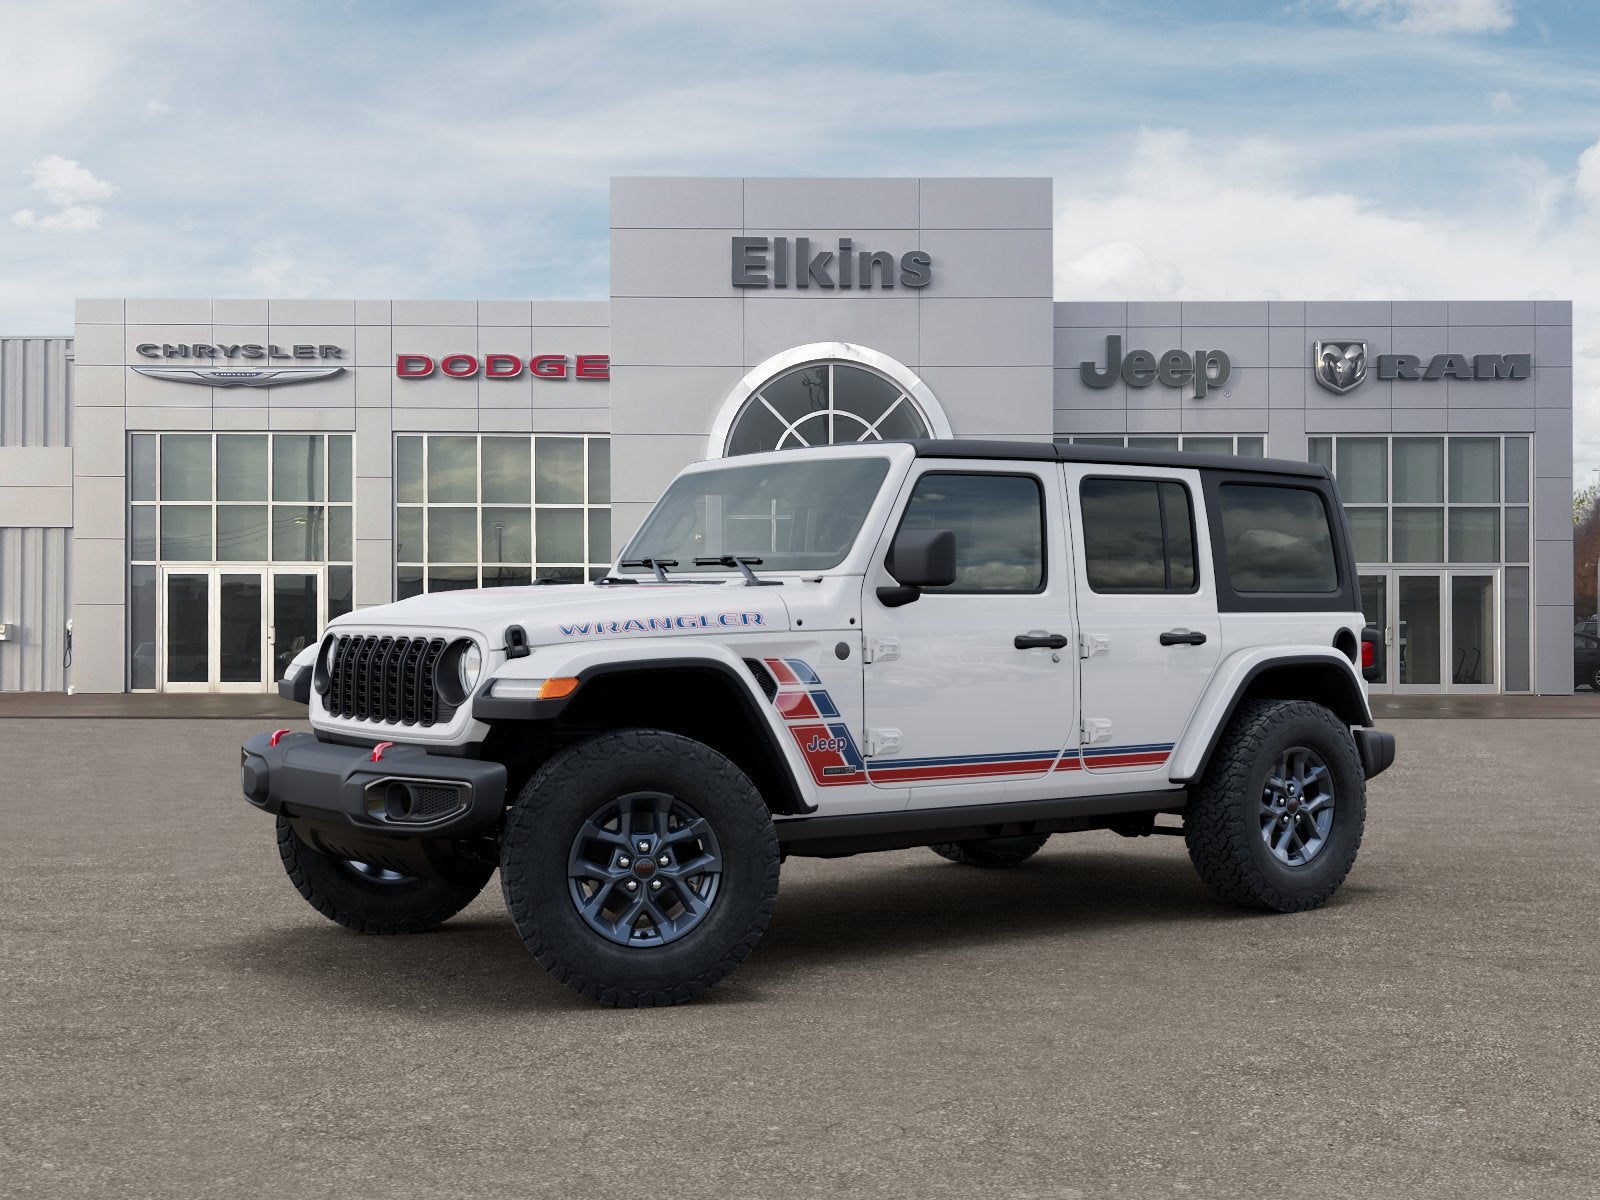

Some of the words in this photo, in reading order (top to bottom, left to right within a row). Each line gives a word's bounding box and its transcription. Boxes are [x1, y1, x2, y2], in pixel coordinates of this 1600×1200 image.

[732, 237, 932, 288] Elkins
[136, 343, 343, 359] CHRYSLER
[396, 353, 610, 380] DODGE
[1080, 335, 1231, 399] Jeep
[1377, 353, 1532, 380] RAM
[558, 611, 766, 637] WRANGLER
[807, 735, 847, 753] Jeep
